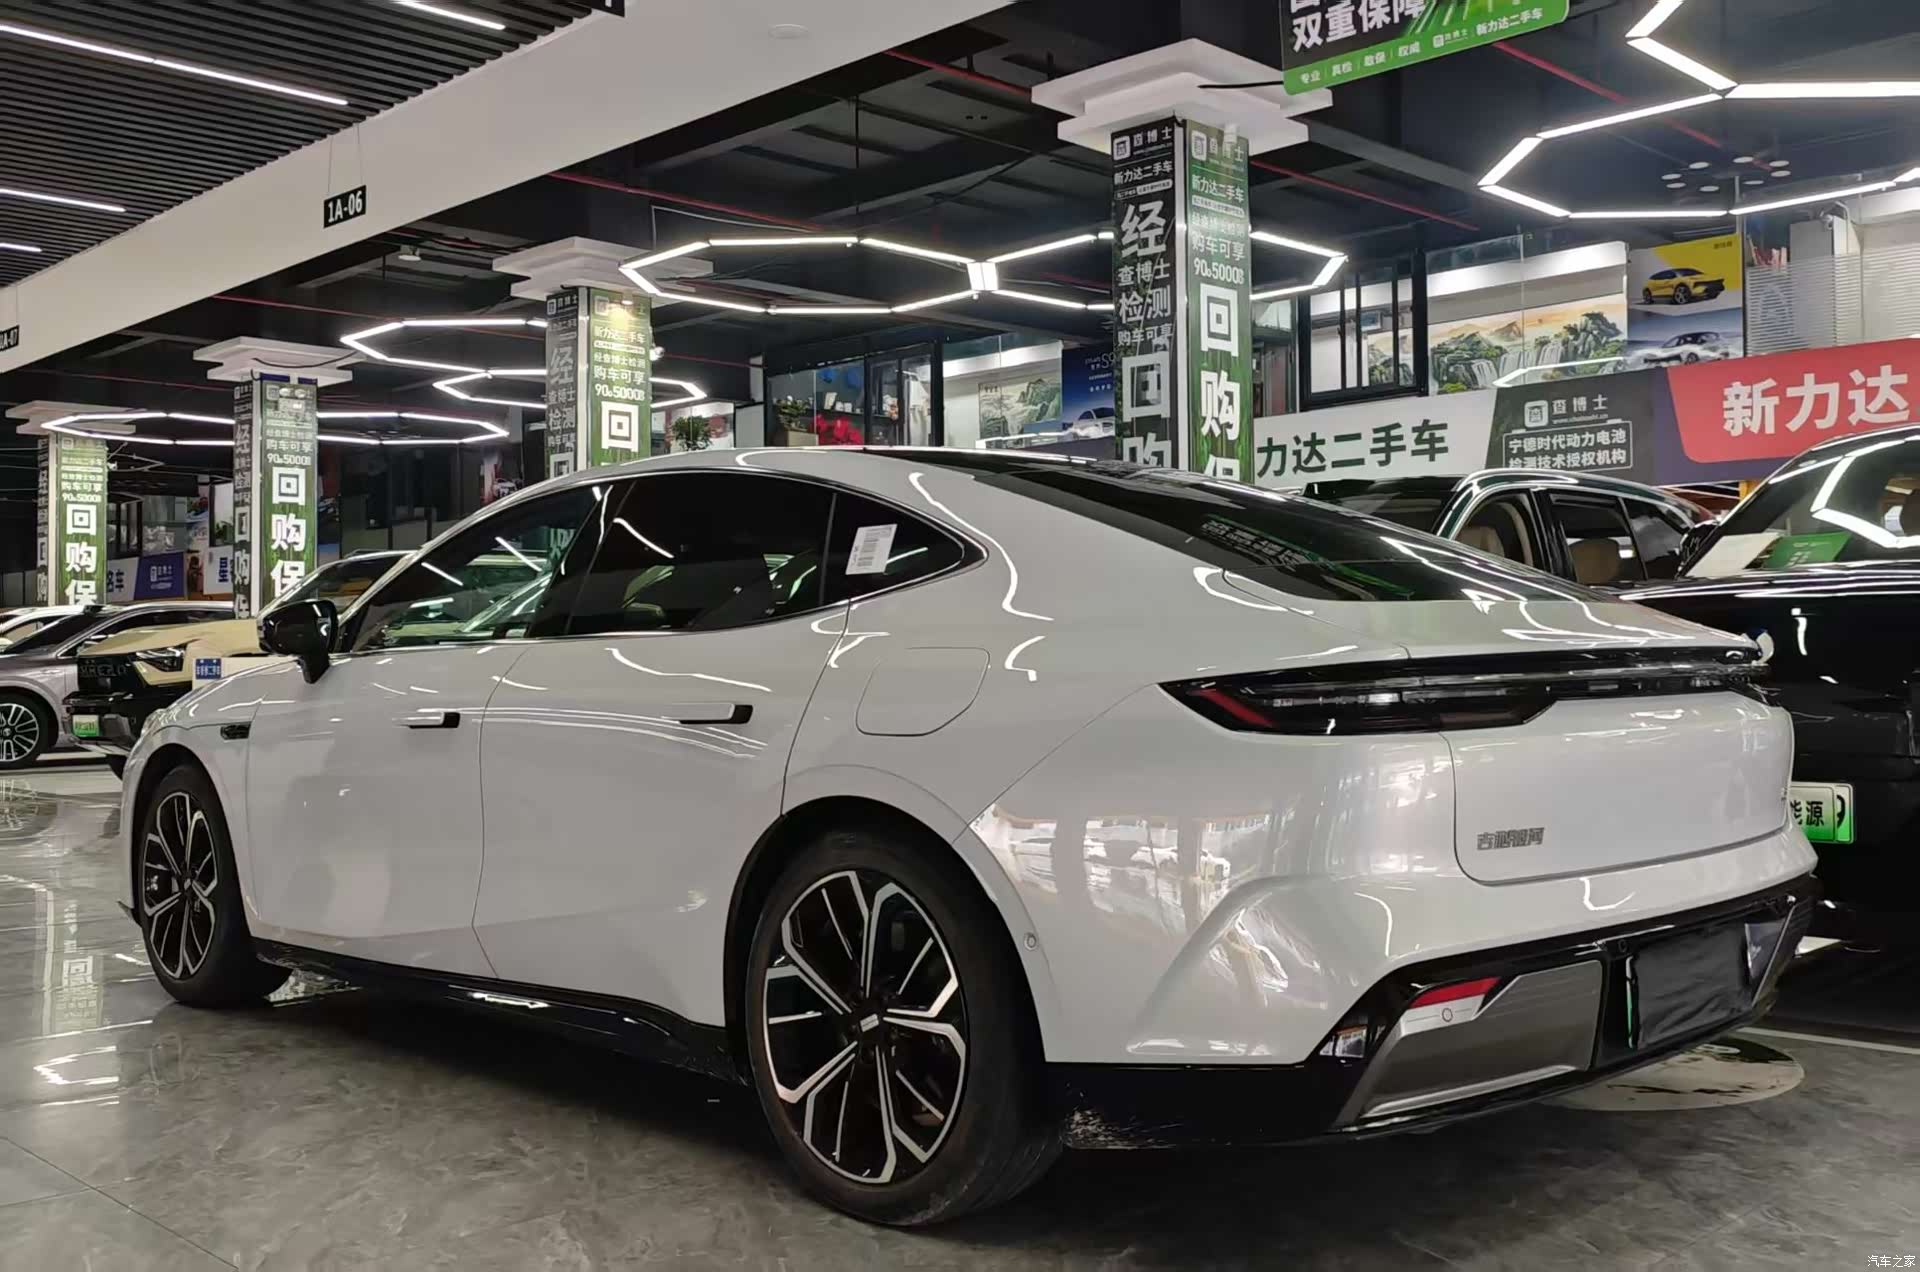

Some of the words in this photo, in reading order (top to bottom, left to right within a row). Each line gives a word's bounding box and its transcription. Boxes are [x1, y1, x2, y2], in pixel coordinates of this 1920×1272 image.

[1292, 0, 1427, 53] 双重保障
[1475, 7, 1543, 36] 新力达二手车
[1113, 160, 1173, 186] 新力达二手车
[1191, 173, 1245, 204] 新力达二手车
[328, 190, 363, 223] 1A-06
[1121, 200, 1167, 259] 经
[1191, 230, 1246, 262] 购车可享
[1117, 258, 1170, 287] 查博士
[1118, 285, 1172, 325] 检测
[1117, 322, 1174, 347] 购车可享
[1552, 394, 1608, 416] 查博士
[1722, 364, 1911, 438] 新力达
[1256, 418, 1449, 479] 力达二手车
[1508, 428, 1627, 454] 宁德时代动力电池
[1508, 448, 1627, 469] 检测技术授权机构
